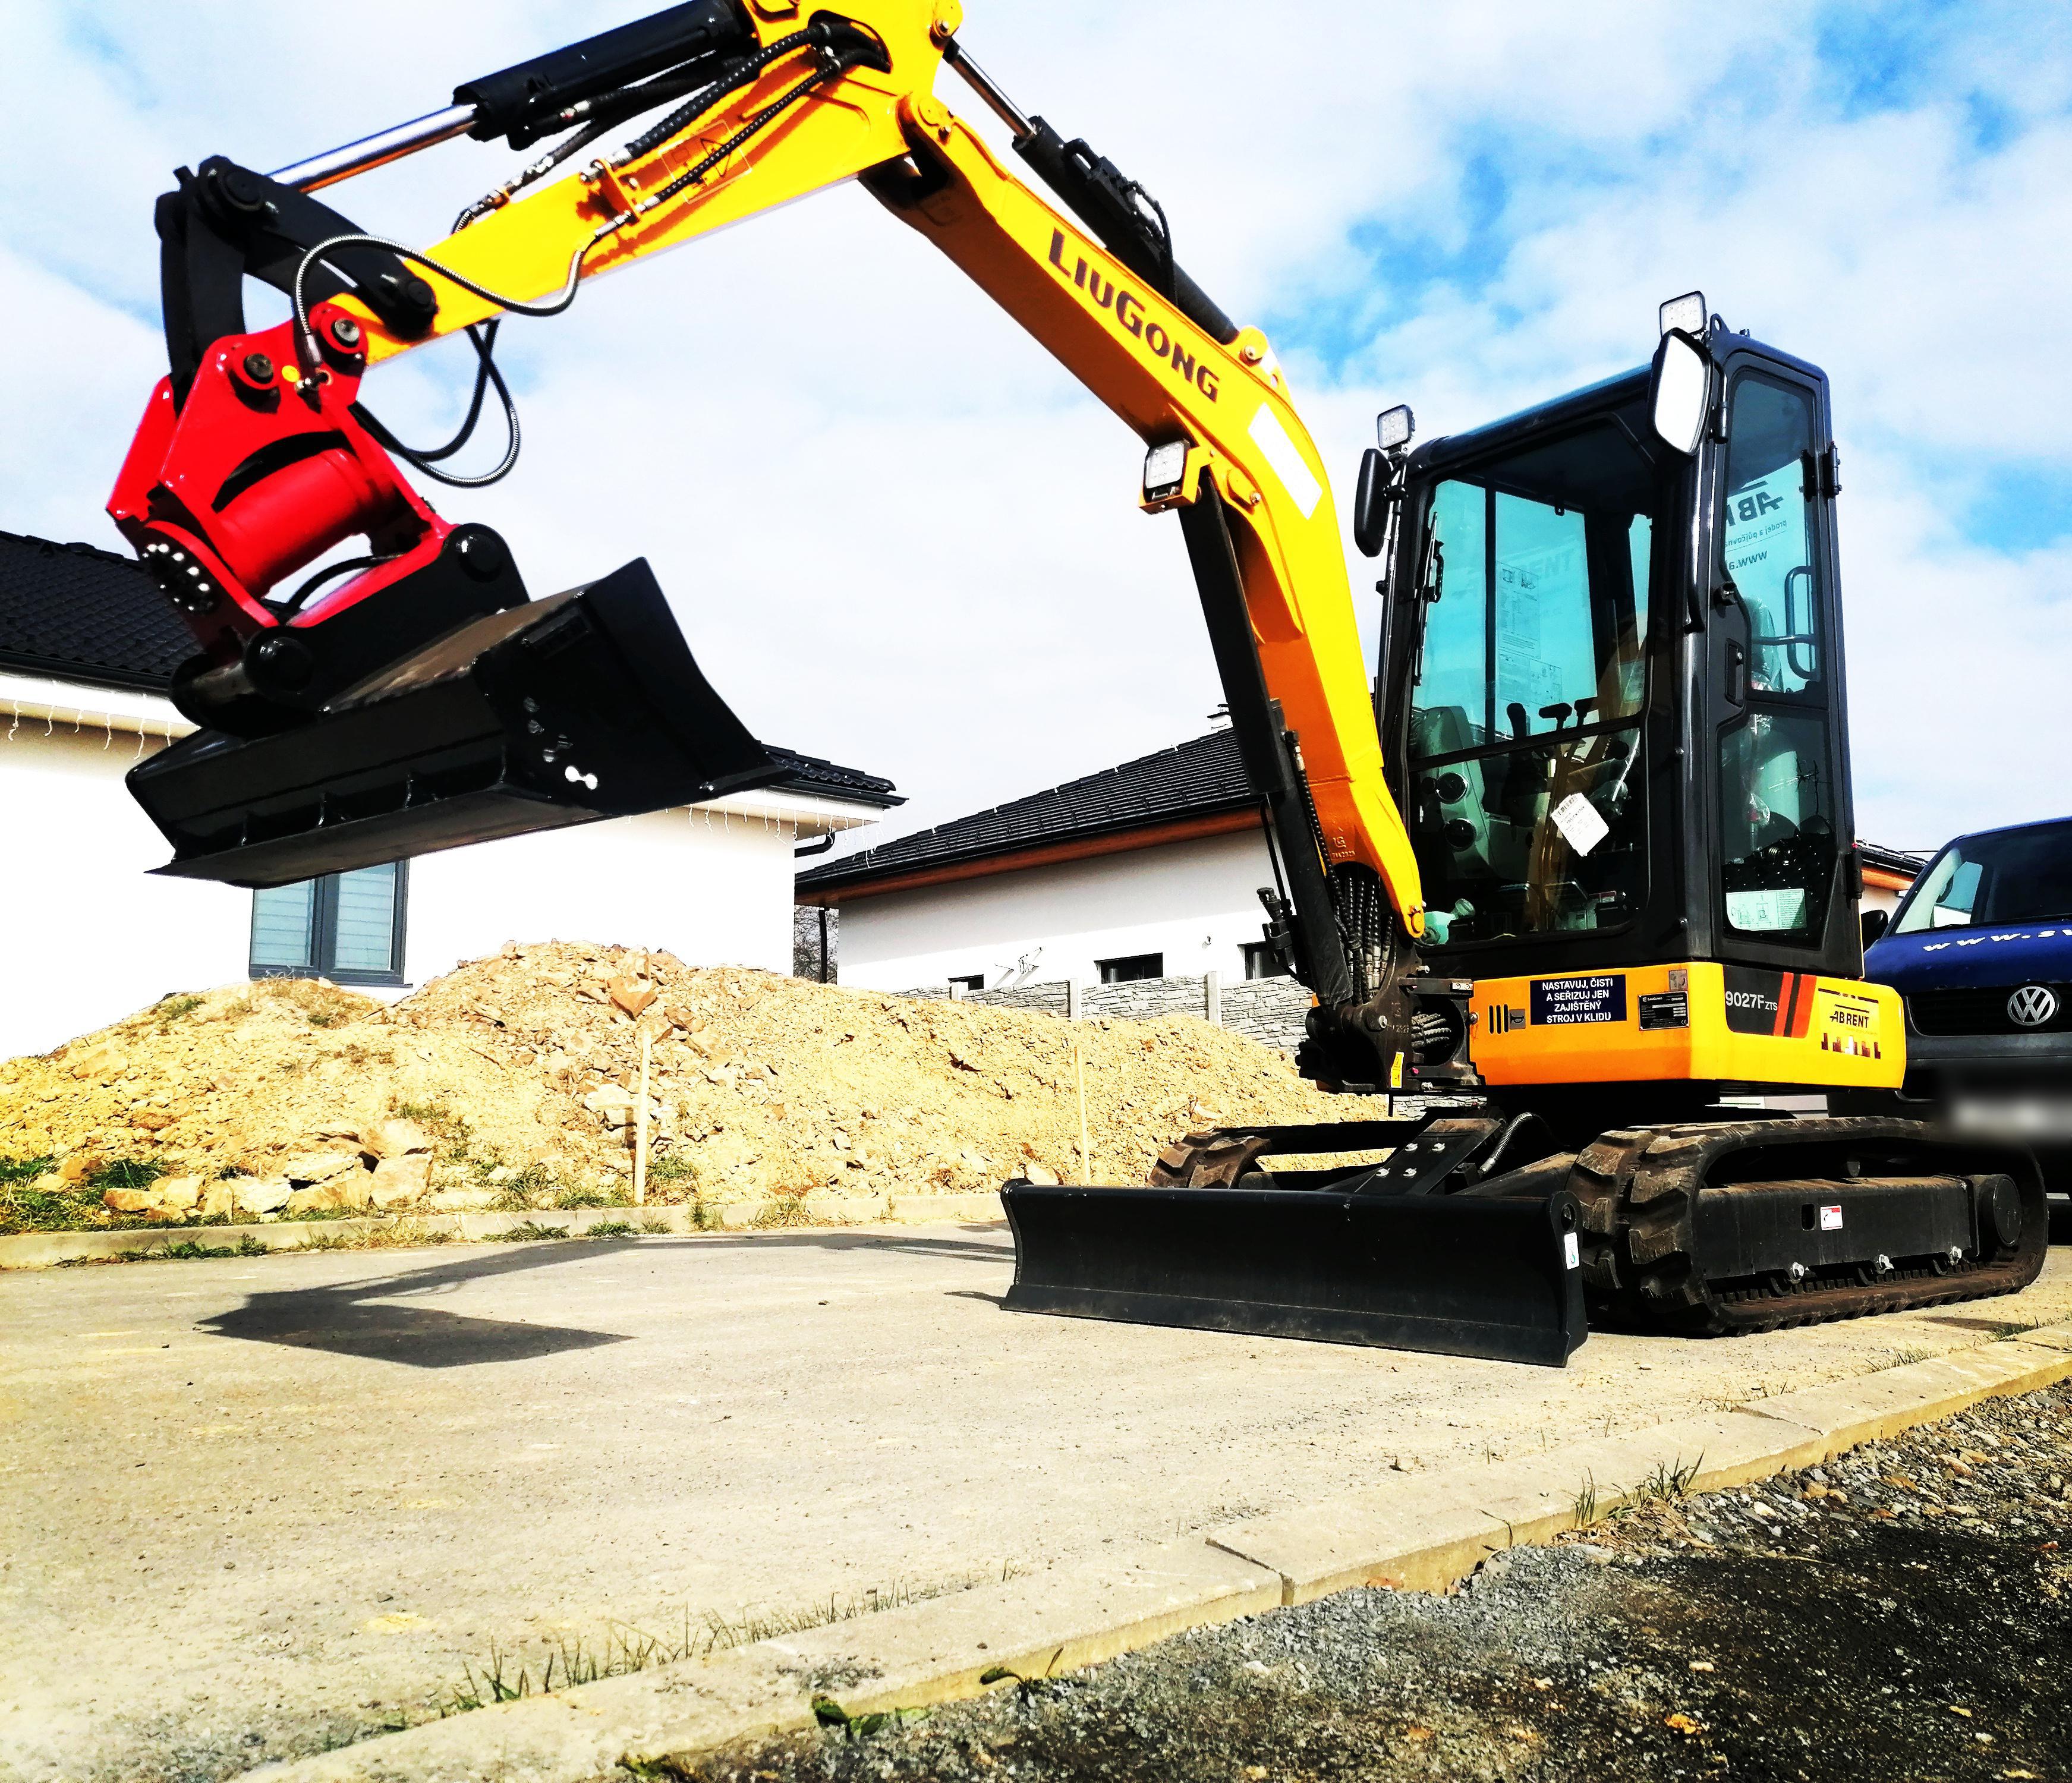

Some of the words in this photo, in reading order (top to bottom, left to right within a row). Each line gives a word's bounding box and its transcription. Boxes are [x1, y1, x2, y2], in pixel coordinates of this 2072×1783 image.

[1048, 228, 1220, 403] LIUGONG
[1542, 980, 1589, 991] NASTAVUJ,
[1591, 978, 1613, 988] ČISTI
[1546, 993, 1553, 1001] A
[1554, 990, 1590, 1001] SEŘIZUJ
[1592, 990, 1610, 998] JEN
[1554, 1000, 1602, 1012] ZAJIŠTĚNÝ
[1547, 1014, 1575, 1023] STROJ
[1576, 1013, 1582, 1022] V
[1584, 1012, 1611, 1022] KLIDU
